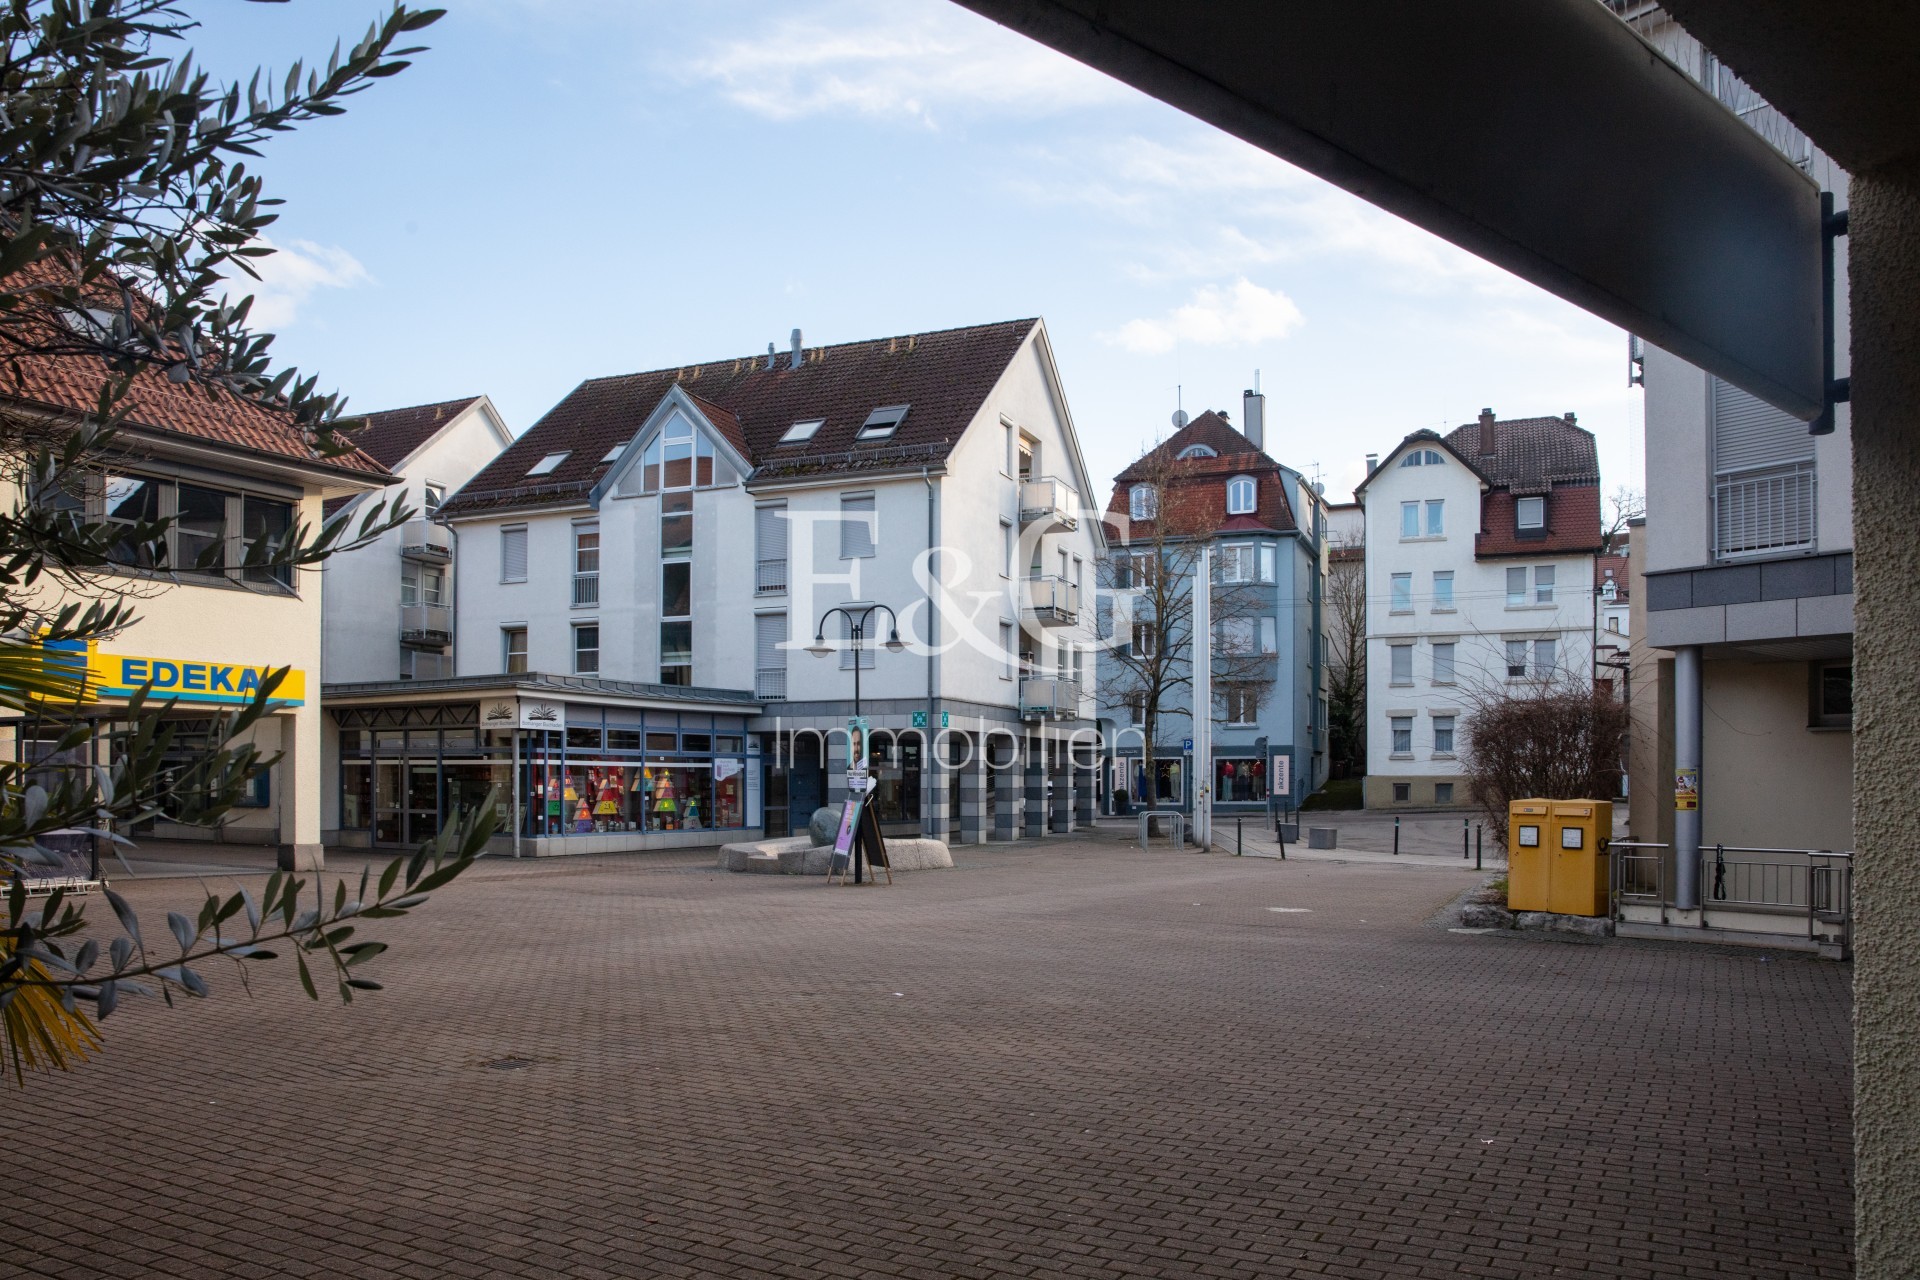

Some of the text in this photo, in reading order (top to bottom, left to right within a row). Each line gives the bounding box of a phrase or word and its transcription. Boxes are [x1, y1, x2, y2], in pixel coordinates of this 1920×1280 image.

[121, 658, 261, 693] EDEKA
[1185, 740, 1192, 749] P
[1277, 760, 1285, 790] akzente
